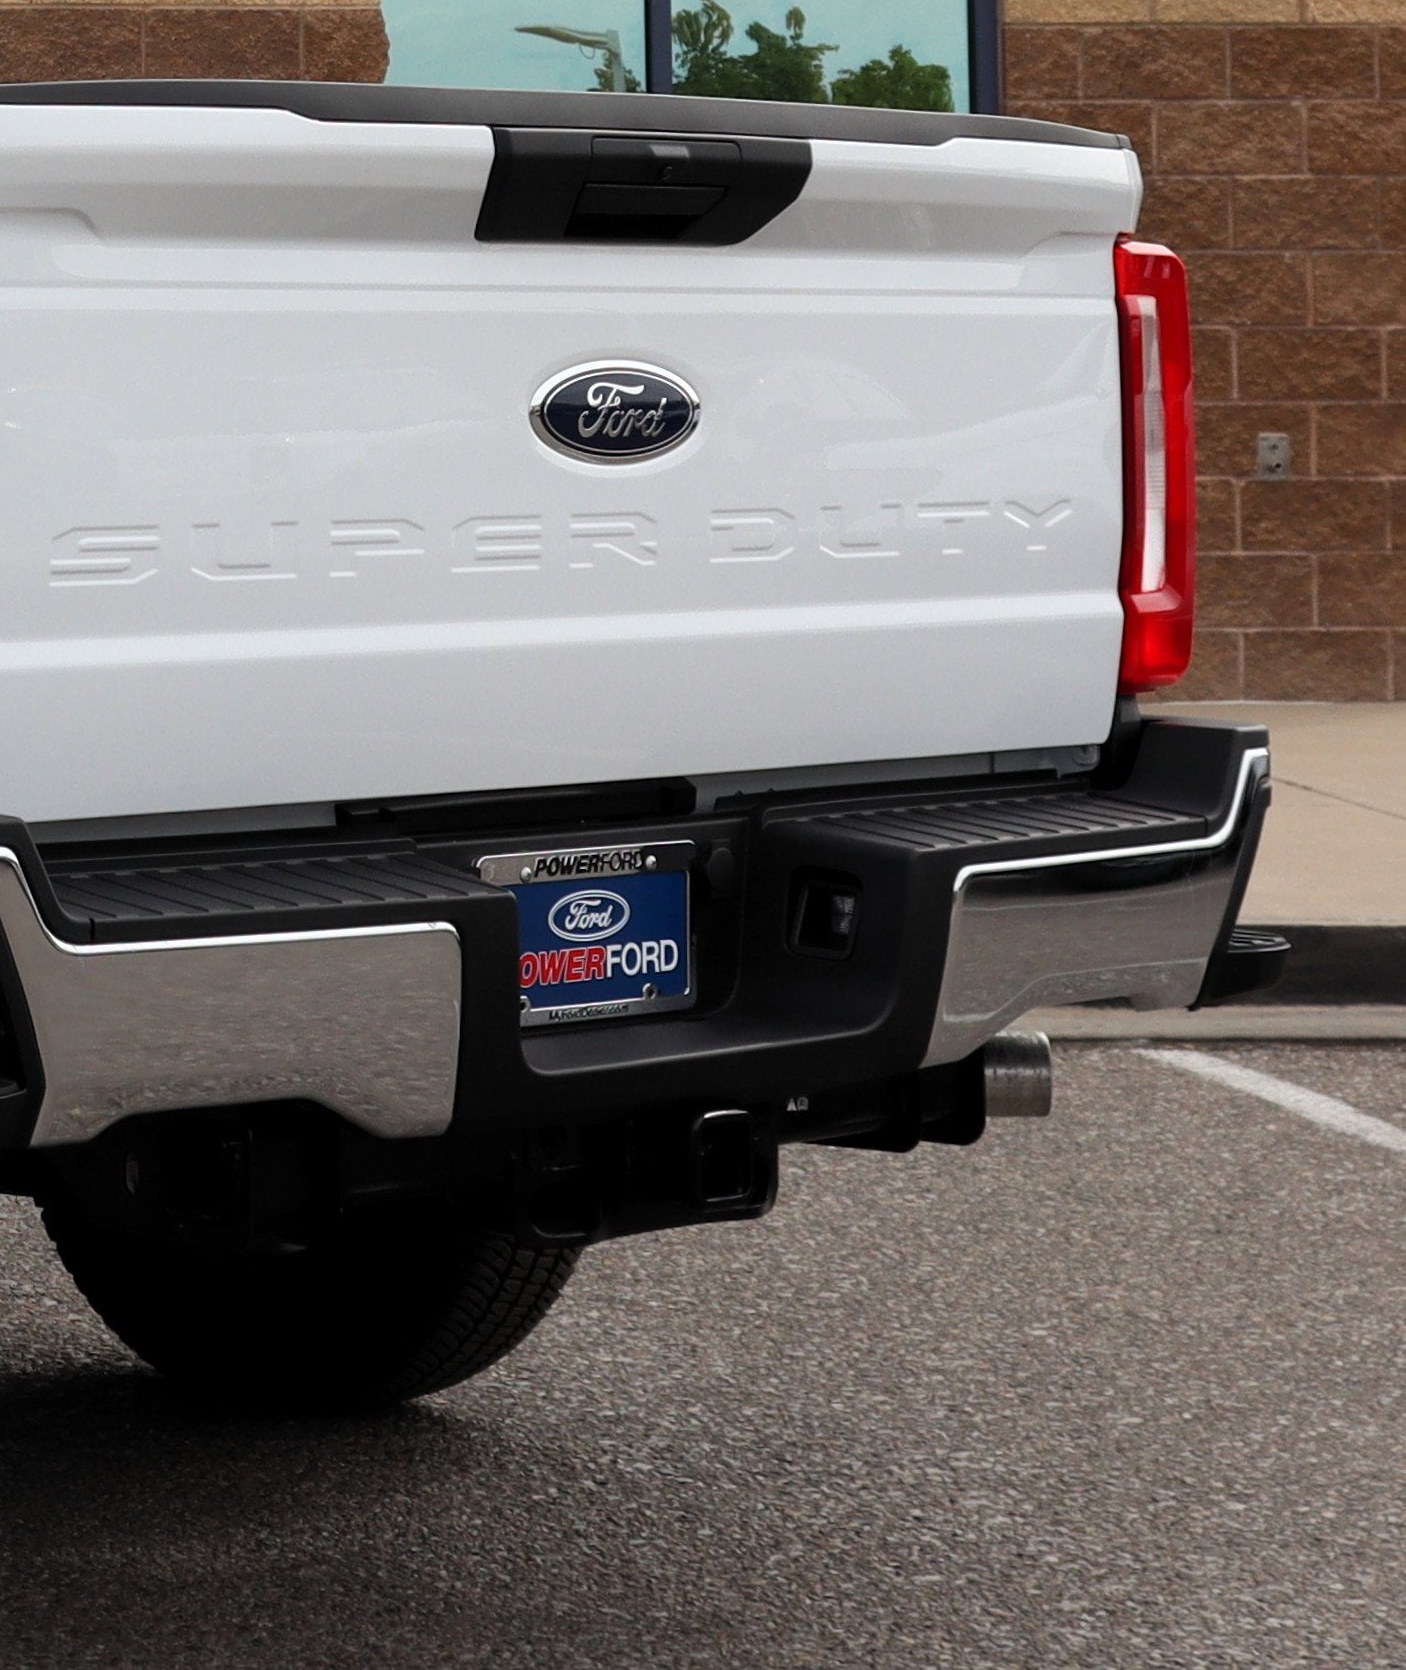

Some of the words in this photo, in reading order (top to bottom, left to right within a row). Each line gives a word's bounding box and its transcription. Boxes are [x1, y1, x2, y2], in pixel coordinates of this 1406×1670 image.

[577, 382, 668, 438] Ford
[48, 510, 658, 587] SUPER
[709, 497, 1074, 565] DUTY
[533, 849, 643, 879] POWERFORD
[564, 898, 613, 930] Ford
[519, 939, 679, 988] OWERFORD
